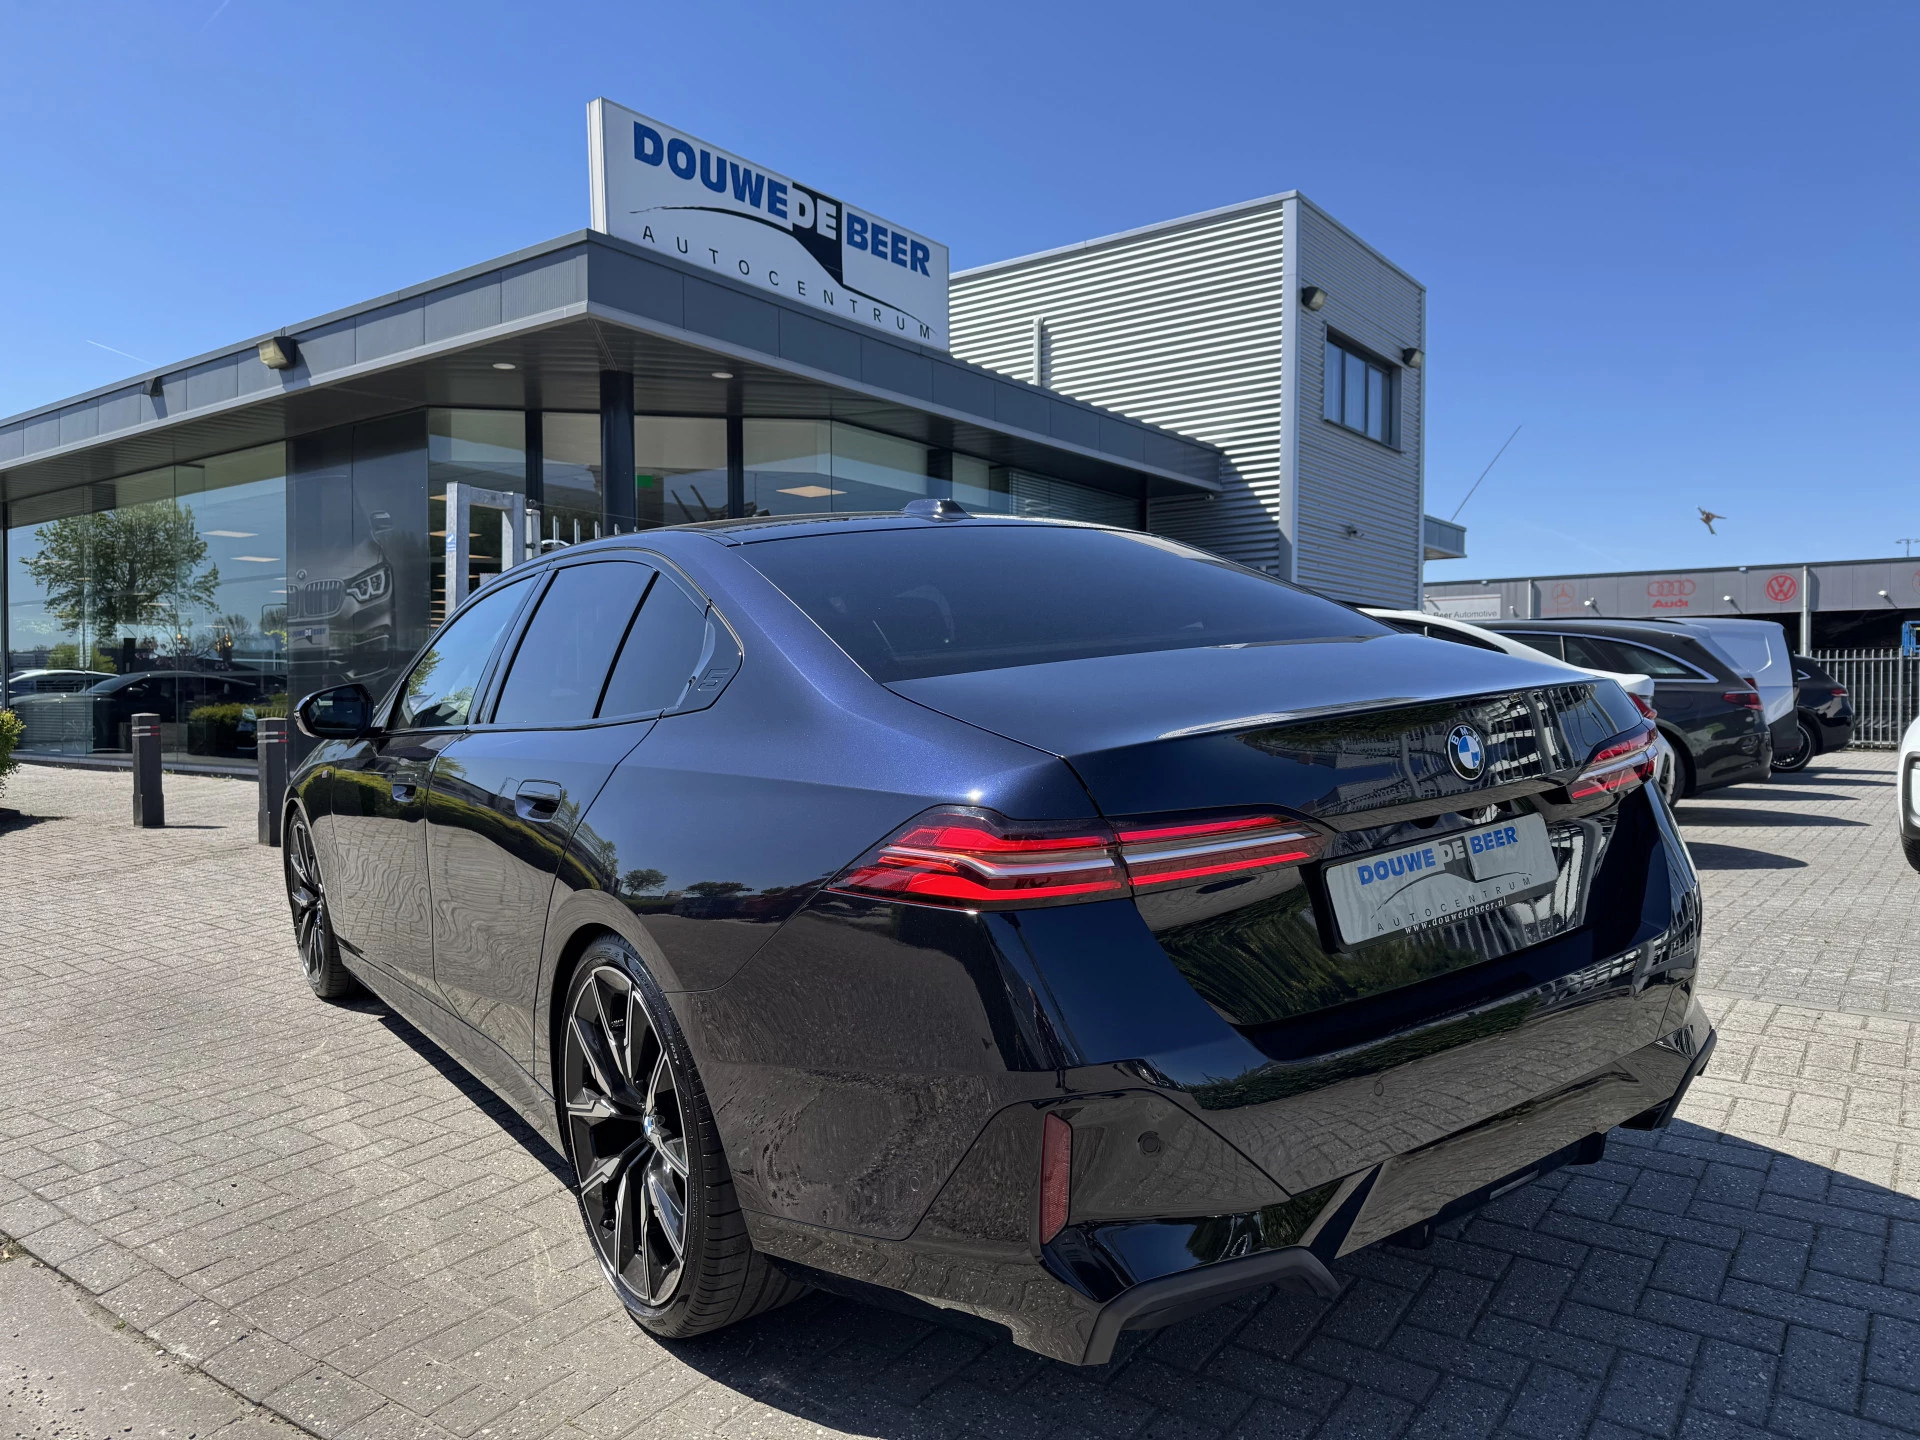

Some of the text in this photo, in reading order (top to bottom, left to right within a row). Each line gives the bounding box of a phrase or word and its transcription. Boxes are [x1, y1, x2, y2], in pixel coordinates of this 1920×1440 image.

[633, 120, 931, 278] DOUWE DE BEER
[642, 225, 931, 340] AUTOCENTRUM
[1454, 609, 1498, 619] Automotive
[1652, 598, 1689, 609] Audi
[1450, 726, 1480, 746] BMW
[1357, 826, 1518, 885] DOUWE DE BEER
[1376, 876, 1531, 932] AUTOCENTRUM
[1404, 896, 1507, 935] www.douwedebeer.nl
